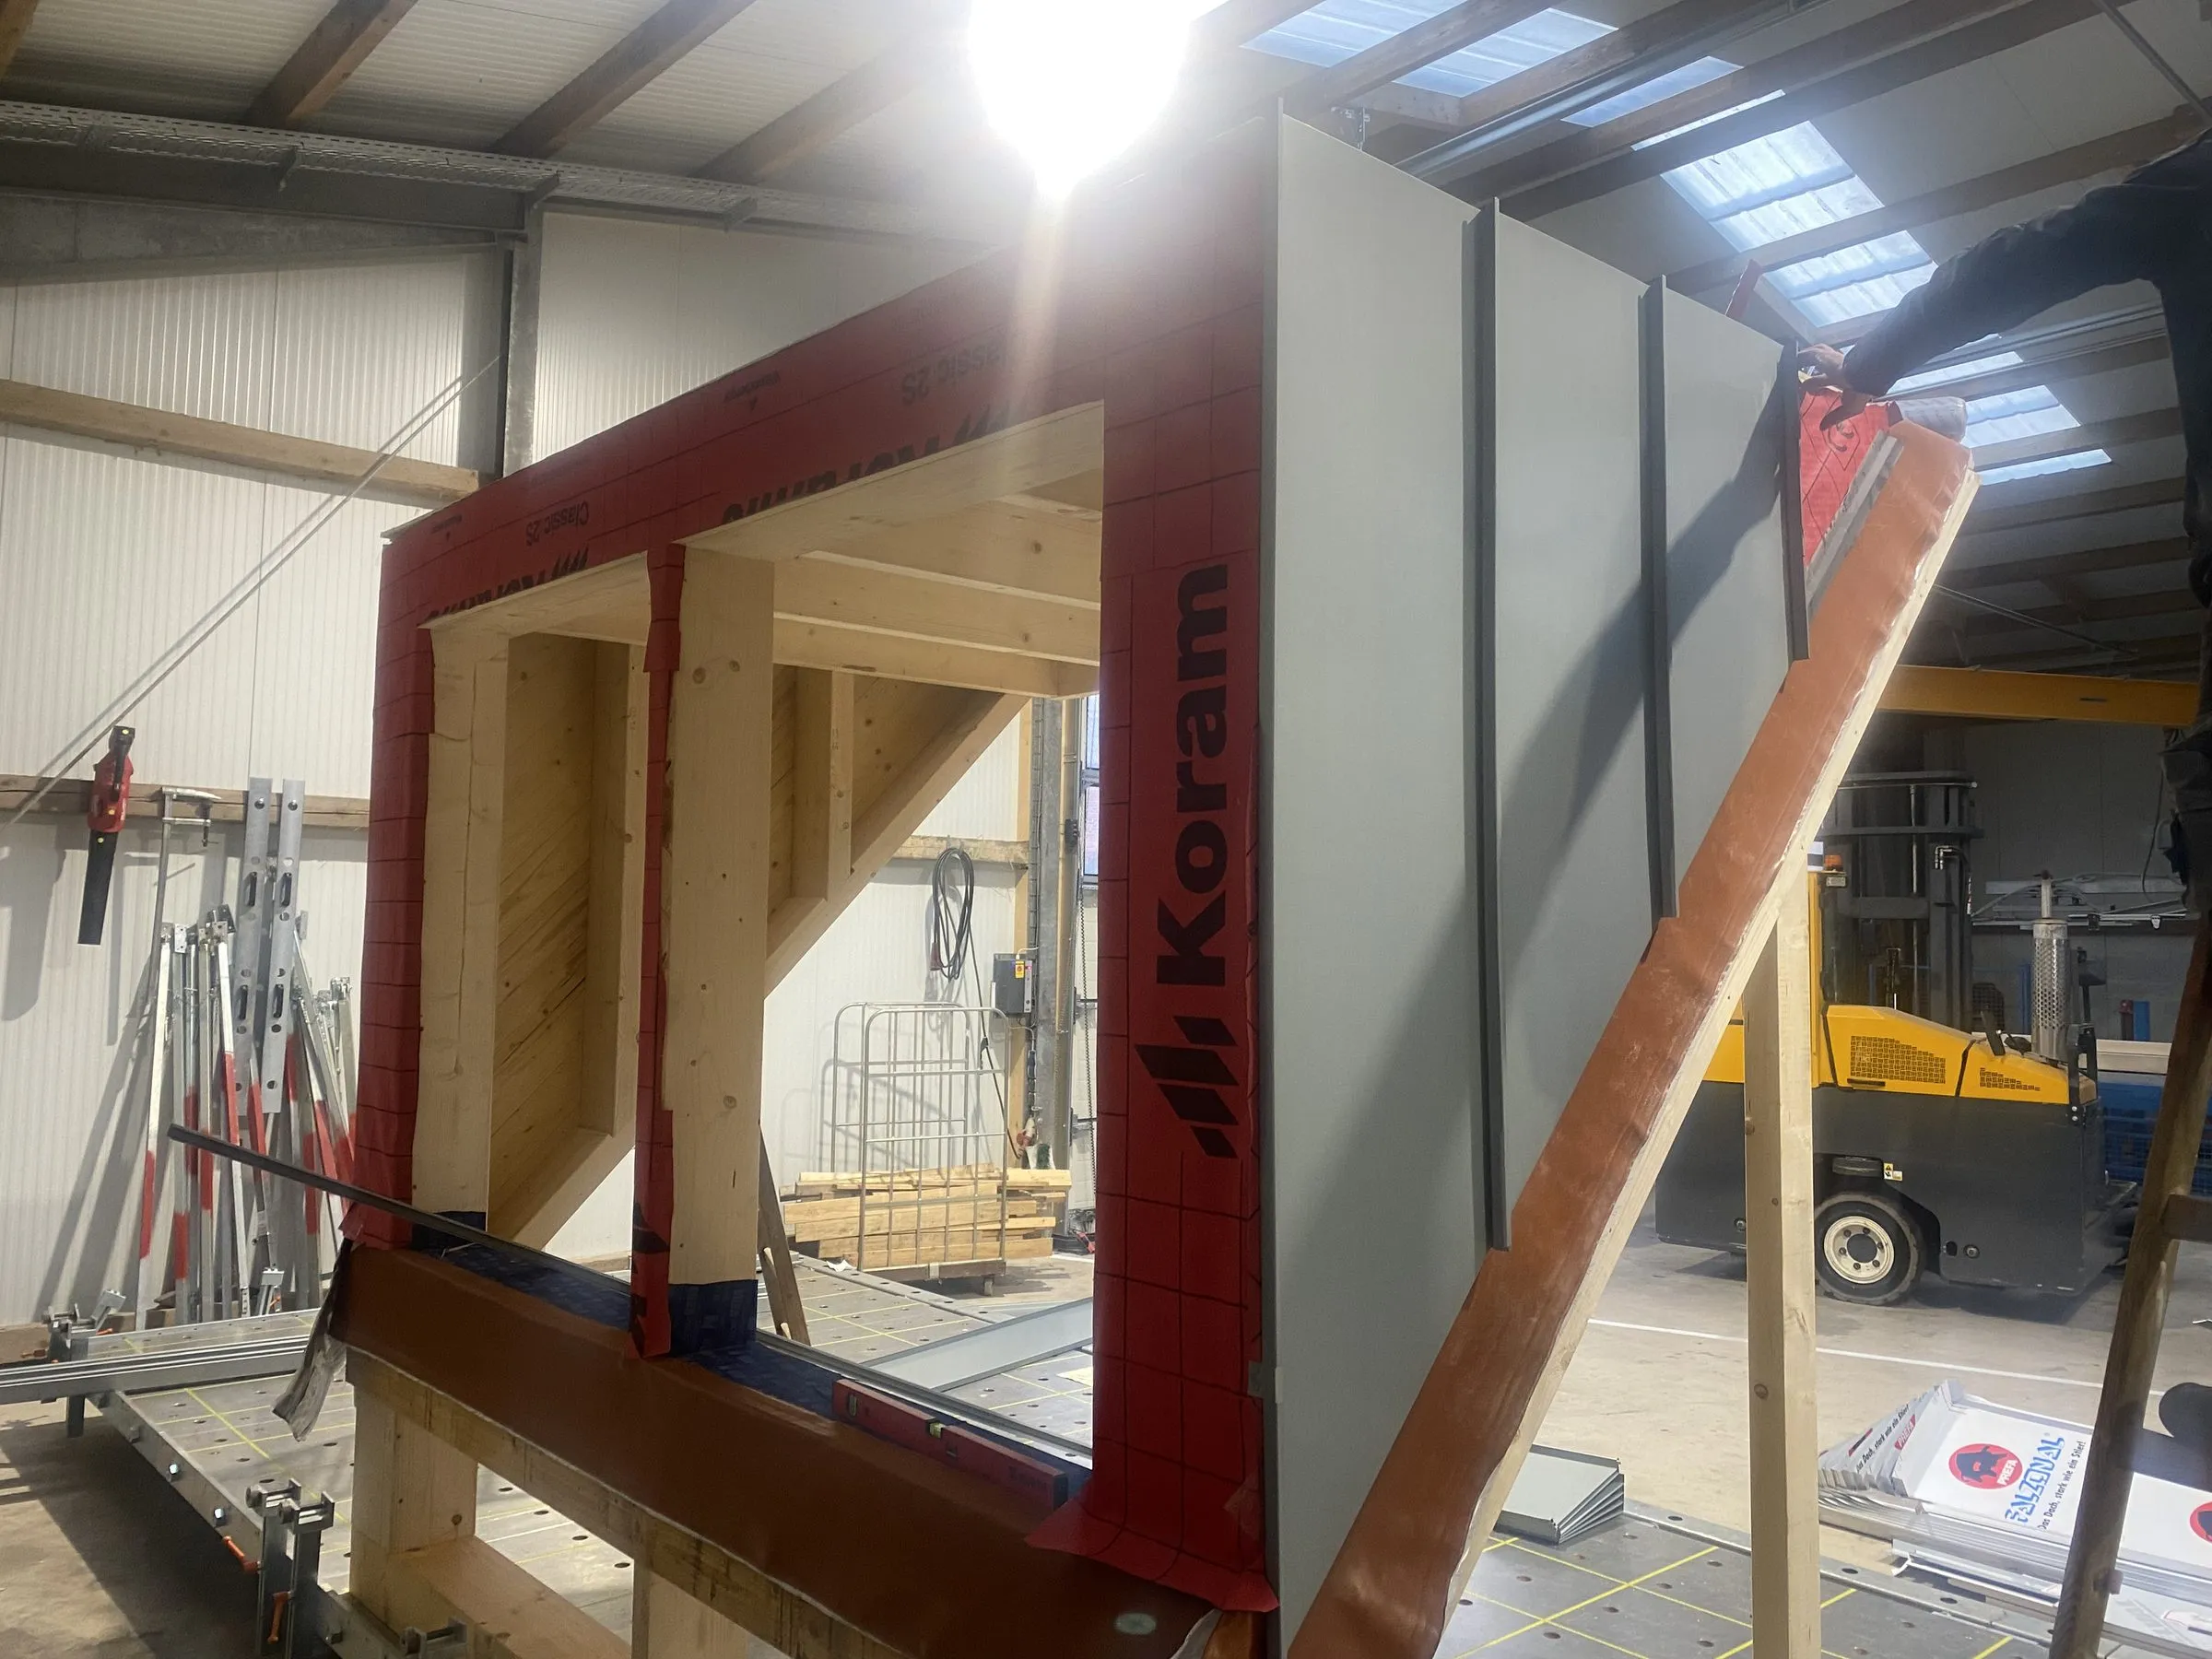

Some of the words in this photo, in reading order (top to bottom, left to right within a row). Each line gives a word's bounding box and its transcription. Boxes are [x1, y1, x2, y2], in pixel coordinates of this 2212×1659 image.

[1875, 1434, 1885, 1450] stark
[2071, 1441, 2086, 1457] Stier!
[1996, 1459, 2018, 1485] PREFA
[2066, 1460, 2077, 1469] ein
[2062, 1471, 2073, 1482] wie
[2055, 1483, 2067, 1499] stark
[2043, 1500, 2060, 1517] Dach,
